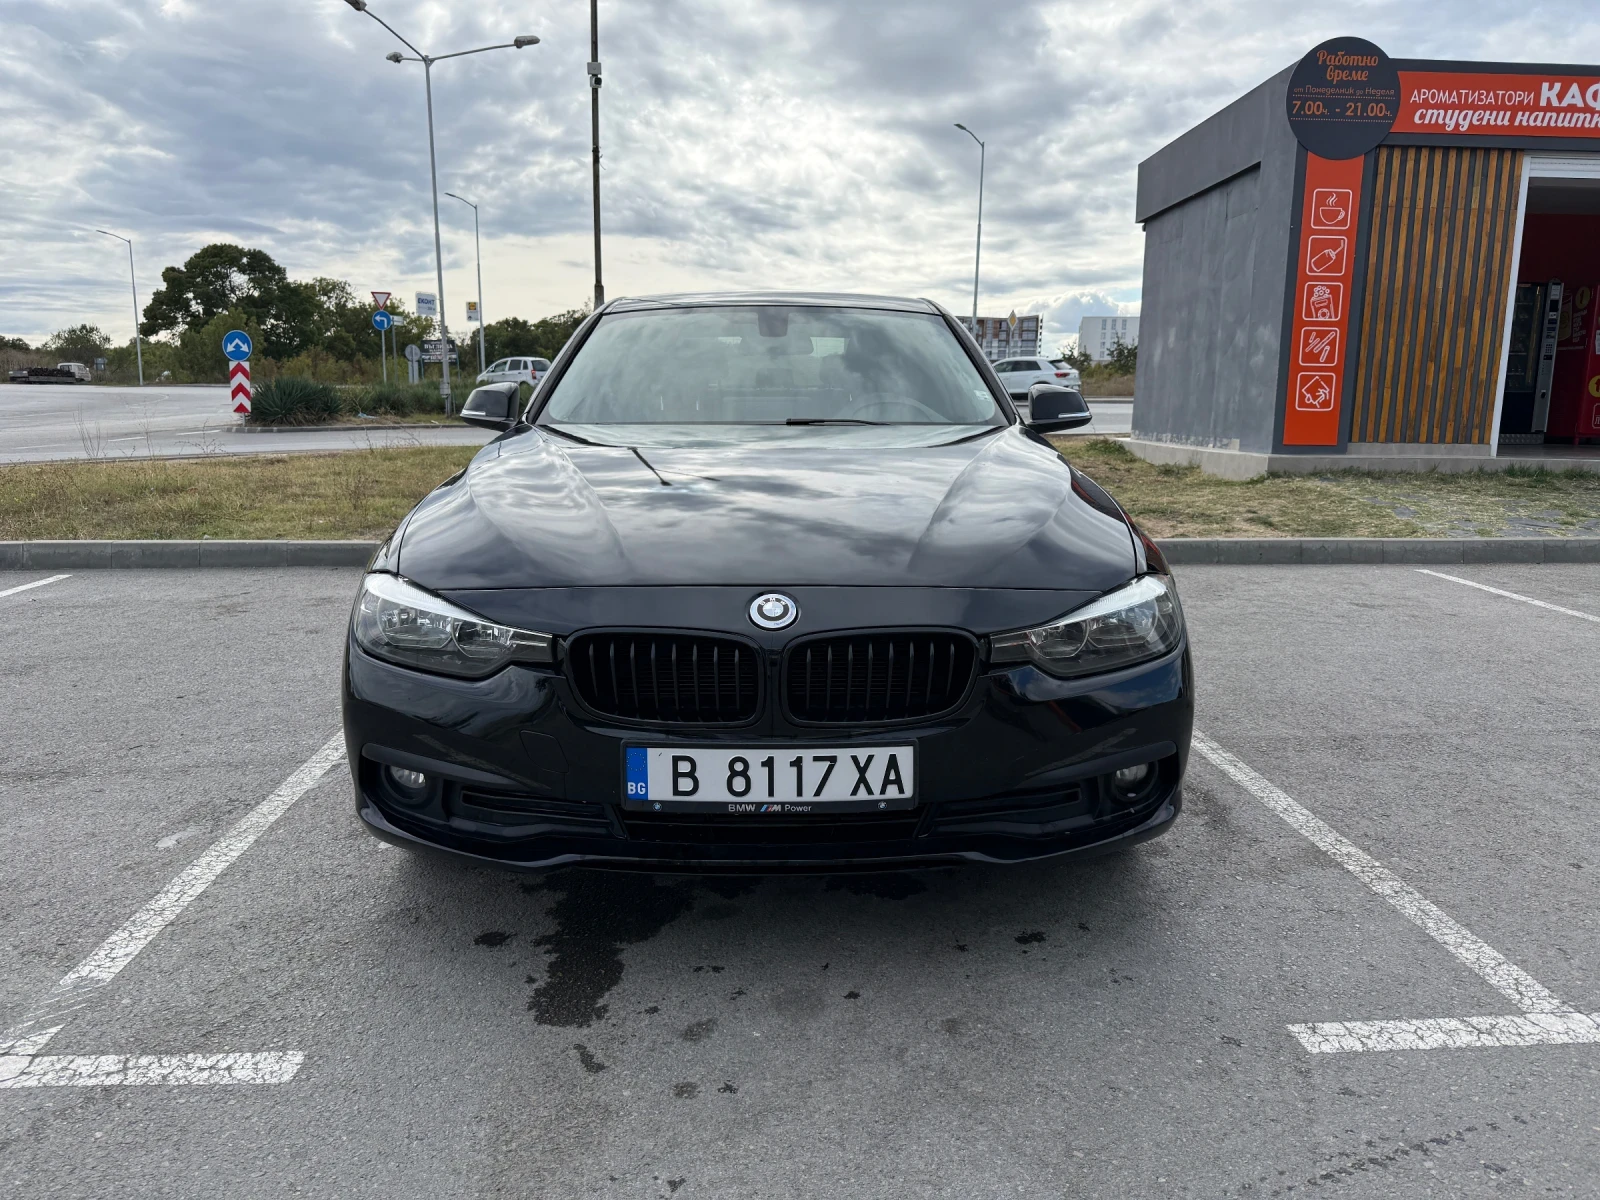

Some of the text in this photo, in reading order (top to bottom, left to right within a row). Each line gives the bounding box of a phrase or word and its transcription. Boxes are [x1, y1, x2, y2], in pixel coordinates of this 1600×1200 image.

[1316, 49, 1379, 66] Работно
[1326, 65, 1369, 84] време
[1305, 85, 1354, 95] Понеделник
[1365, 87, 1395, 96] Неделя
[1410, 89, 1535, 106] АРОМАТИЗАТОРИ
[1414, 108, 1510, 131] студени
[627, 753, 906, 798] BG B 8117 XA
[728, 804, 756, 812] BMW
[784, 804, 812, 812] Power
